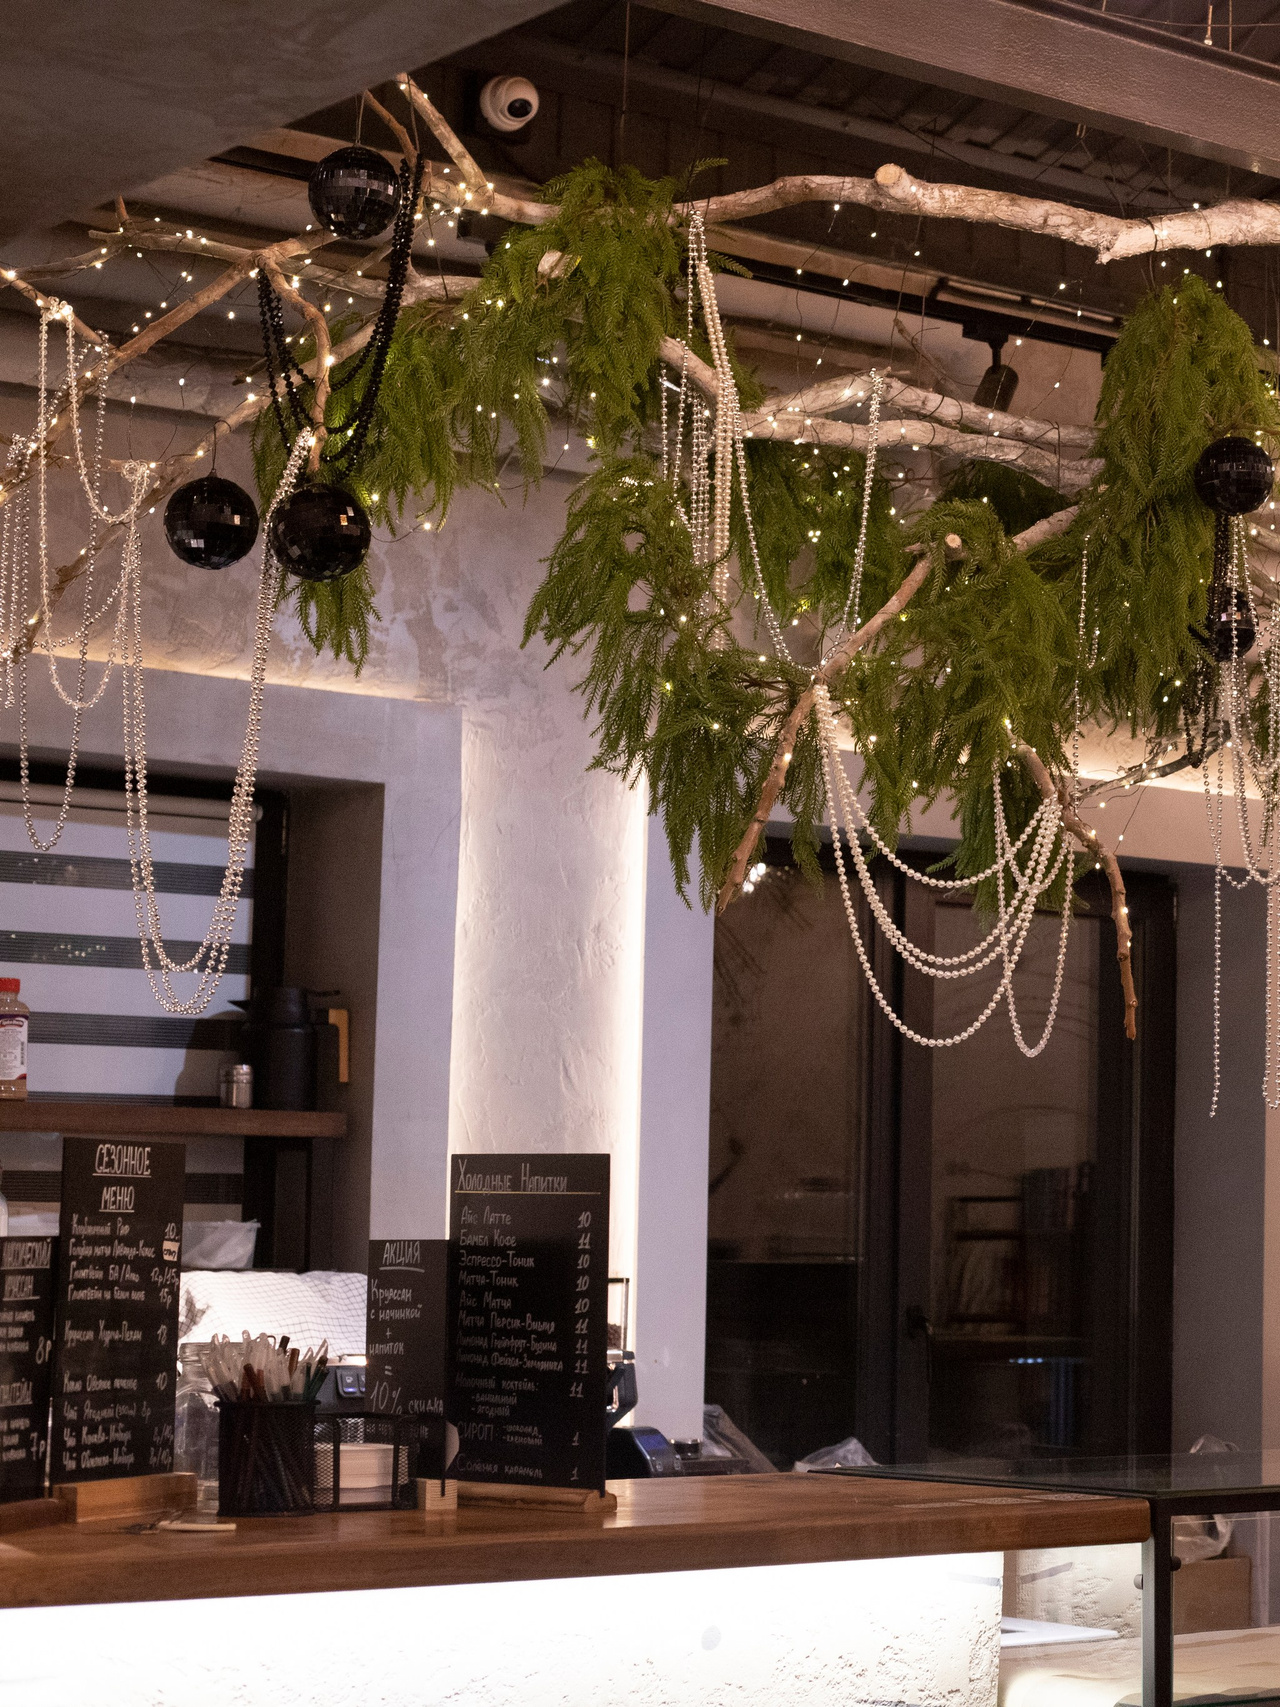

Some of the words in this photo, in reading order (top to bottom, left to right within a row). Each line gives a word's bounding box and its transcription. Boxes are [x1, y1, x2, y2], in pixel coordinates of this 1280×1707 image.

[95, 1144, 151, 1175] СЕЗОННОЕ
[101, 1186, 135, 1210] МЕНЮ
[577, 1211, 592, 1229] 10
[577, 1232, 591, 1249] 11
[382, 1240, 421, 1265] АКЦИЯ
[577, 1254, 590, 1269] 10
[575, 1275, 590, 1292] 10
[574, 1298, 590, 1314] 10
[575, 1318, 589, 1334] 11
[575, 1338, 589, 1354] 11
[574, 1359, 589, 1375] 11
[156, 1372, 168, 1391] 10
[569, 1381, 584, 1398] 11
[370, 1381, 403, 1414] 10%
